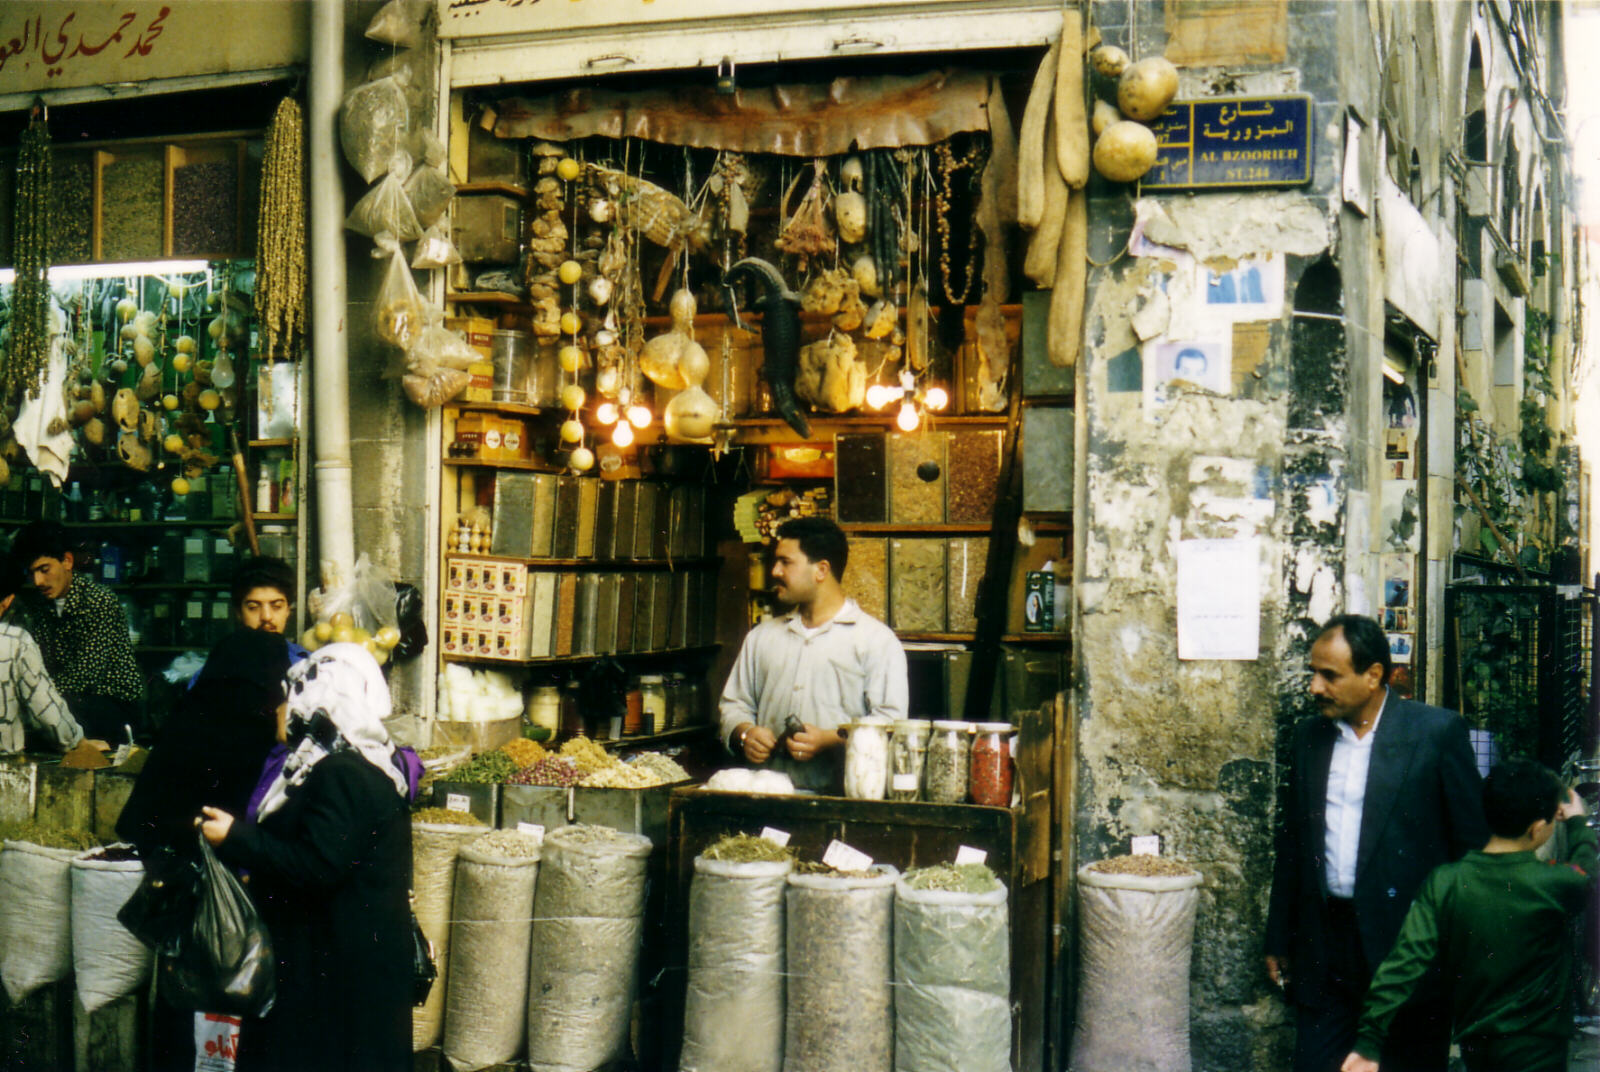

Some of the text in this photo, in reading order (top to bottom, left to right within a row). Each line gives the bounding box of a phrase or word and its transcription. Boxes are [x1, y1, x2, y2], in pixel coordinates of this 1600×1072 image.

[124, 6, 171, 59] محمد
[42, 12, 137, 78] حمدي
[1219, 101, 1275, 125] شارع
[1203, 119, 1294, 142] البزورية
[1200, 149, 1299, 162] AL BZOORIEH
